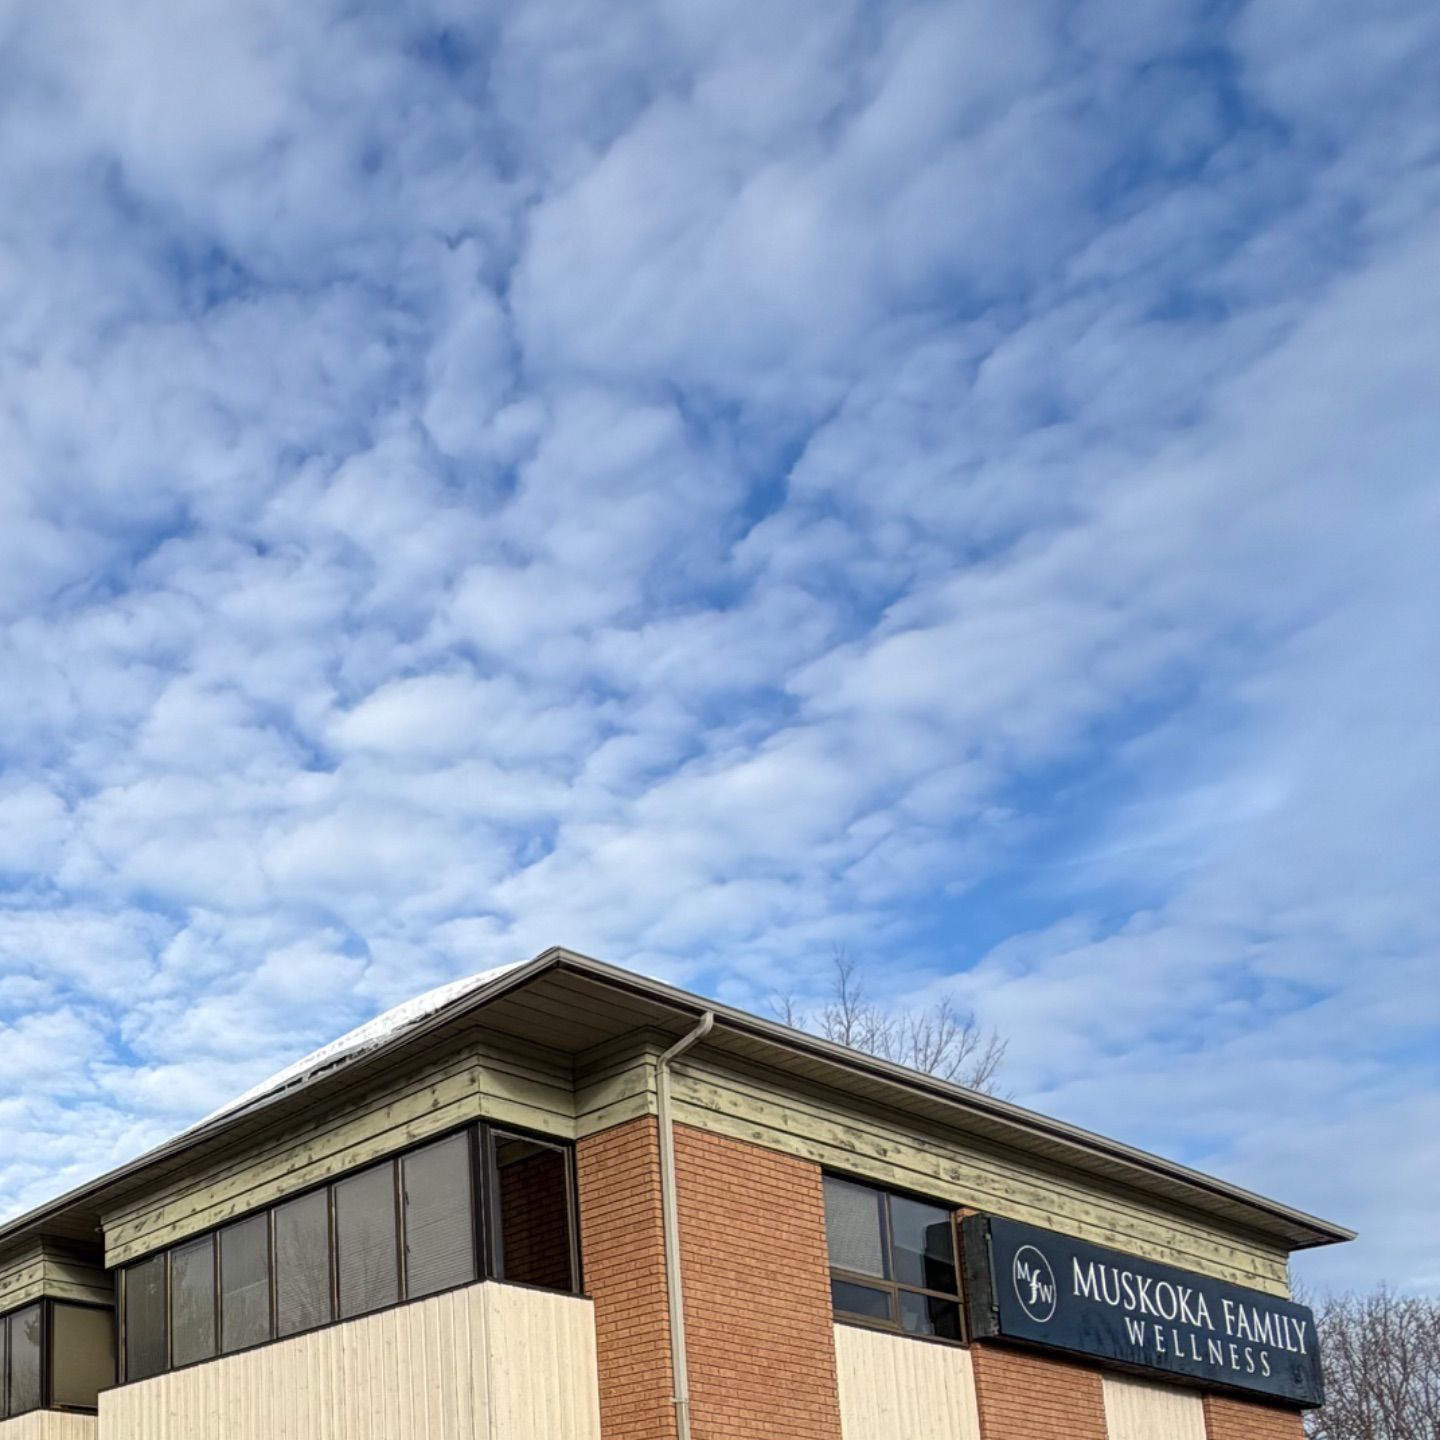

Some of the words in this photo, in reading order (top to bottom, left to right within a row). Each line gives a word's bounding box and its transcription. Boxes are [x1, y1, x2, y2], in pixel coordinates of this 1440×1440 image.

[1072, 1256, 1216, 1331] MUSKOKA
[1222, 1299, 1308, 1355] FAMILY
[1124, 1316, 1271, 1378] WELLNESS
